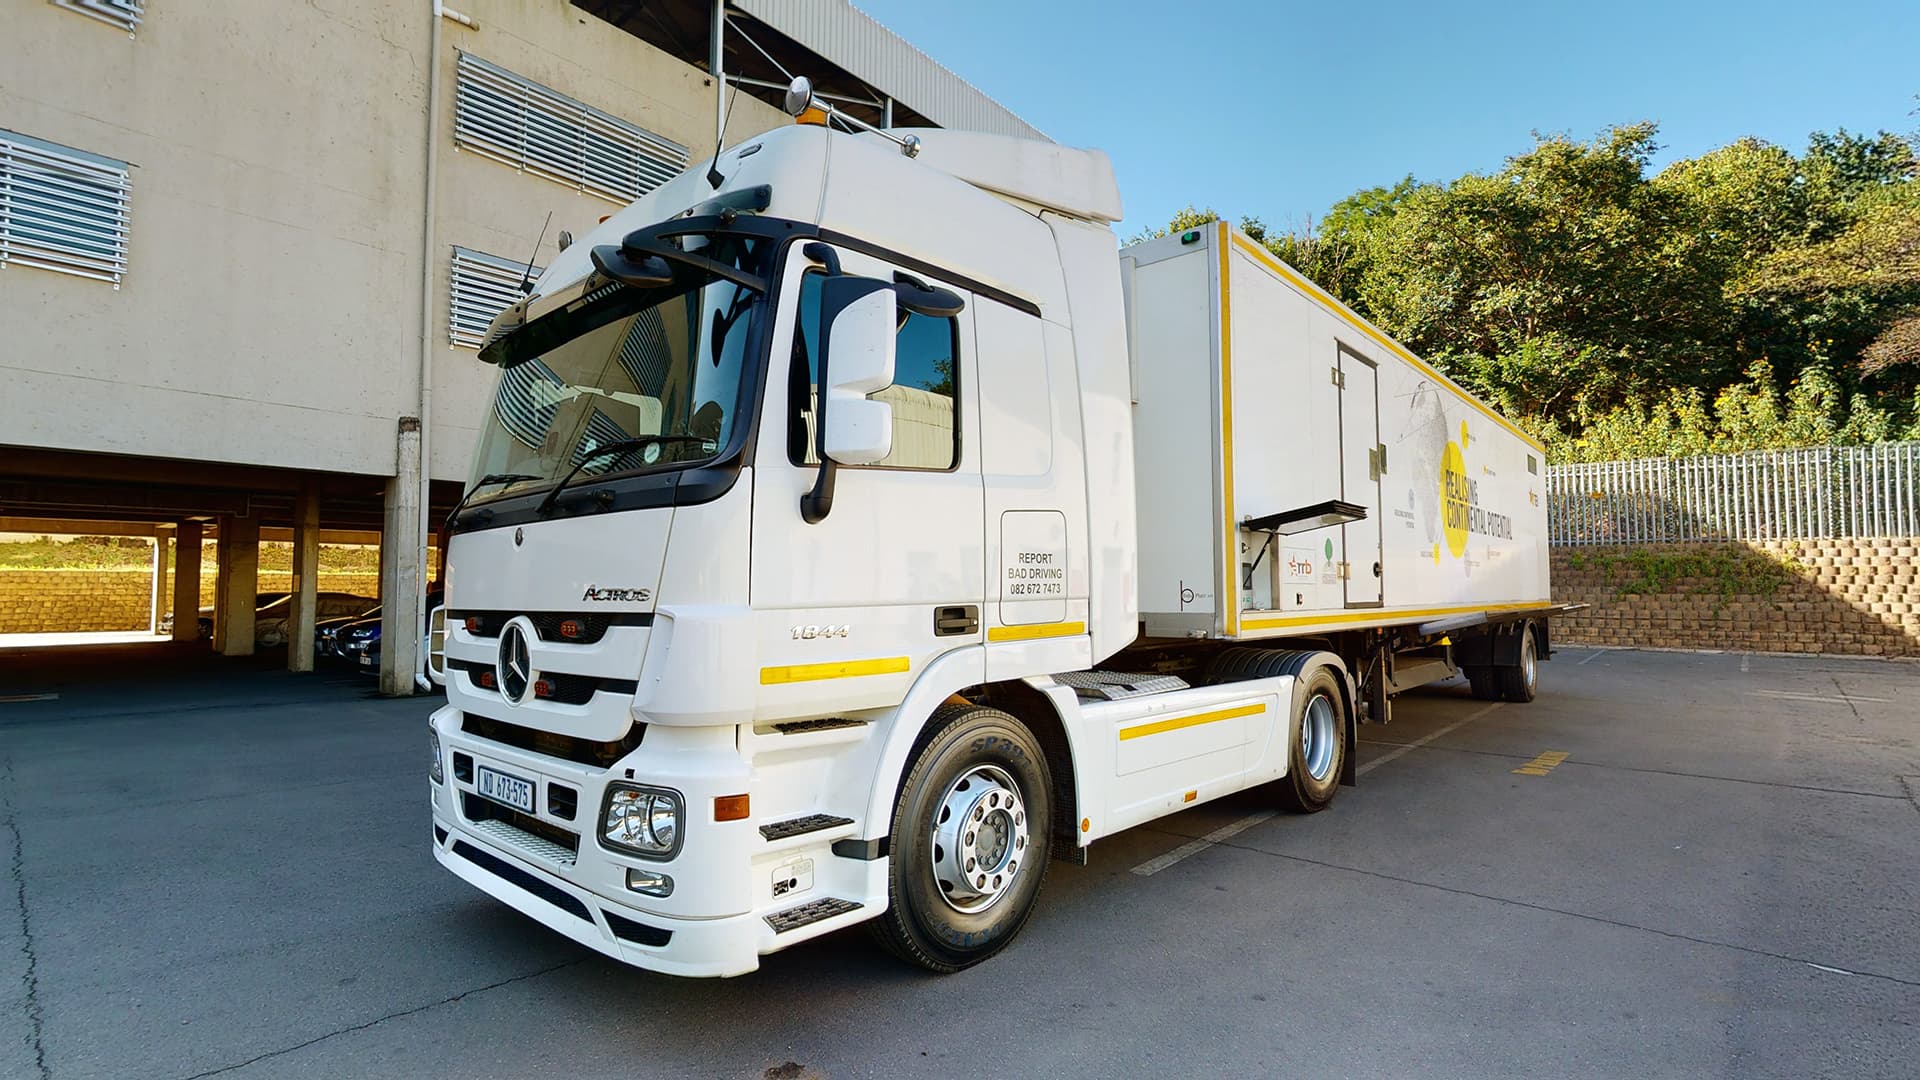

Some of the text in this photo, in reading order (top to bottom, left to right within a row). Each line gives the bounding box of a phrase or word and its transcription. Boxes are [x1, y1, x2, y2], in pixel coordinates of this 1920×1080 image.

[1446, 469, 1478, 506] REALISING
[1447, 499, 1512, 540] CONTINENTAL POTENTIAL
[1018, 552, 1053, 564] REPORT
[1008, 567, 1063, 579] BAD DRIVING
[1010, 583, 1061, 595] 082 672 7473
[790, 624, 851, 640] 1844
[483, 771, 529, 807] ND 673-575
